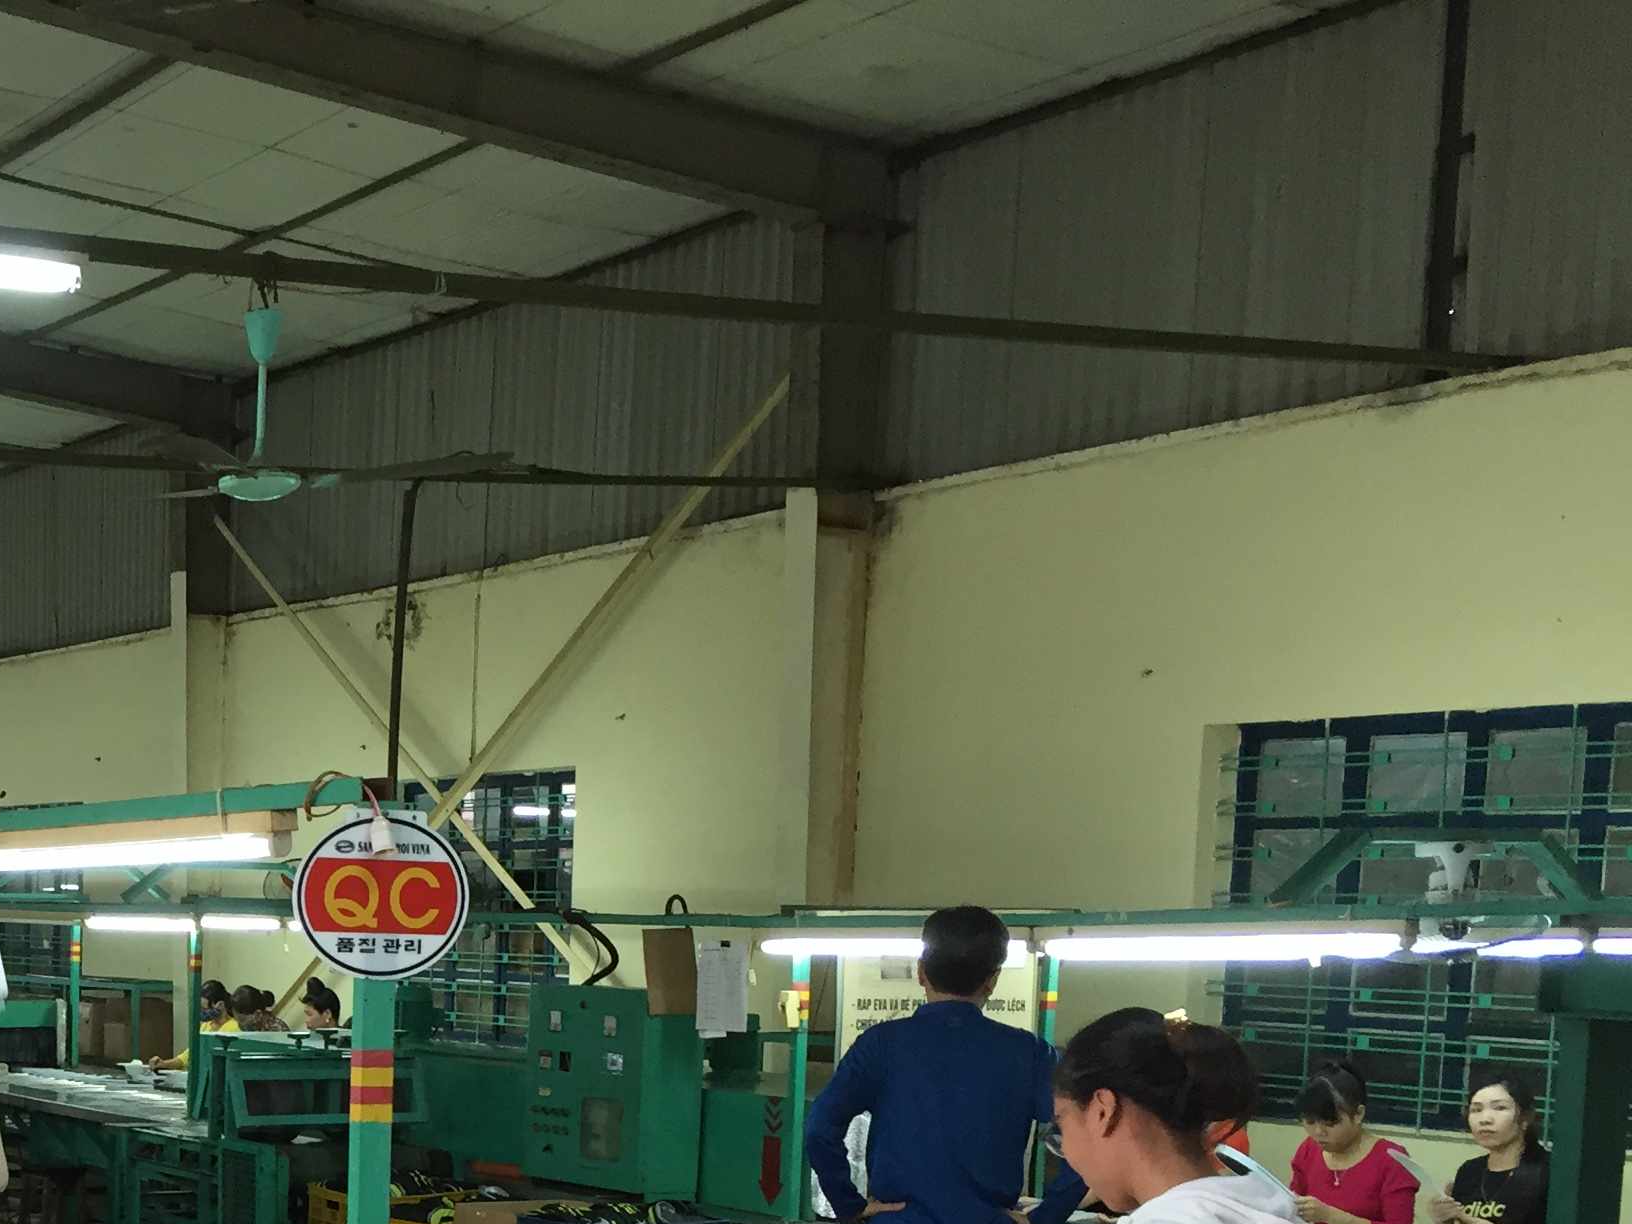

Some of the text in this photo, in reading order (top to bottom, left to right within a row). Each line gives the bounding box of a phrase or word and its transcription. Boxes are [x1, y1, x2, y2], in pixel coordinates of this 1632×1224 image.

[324, 864, 441, 929] QC
[336, 937, 422, 955] 품질 관리
